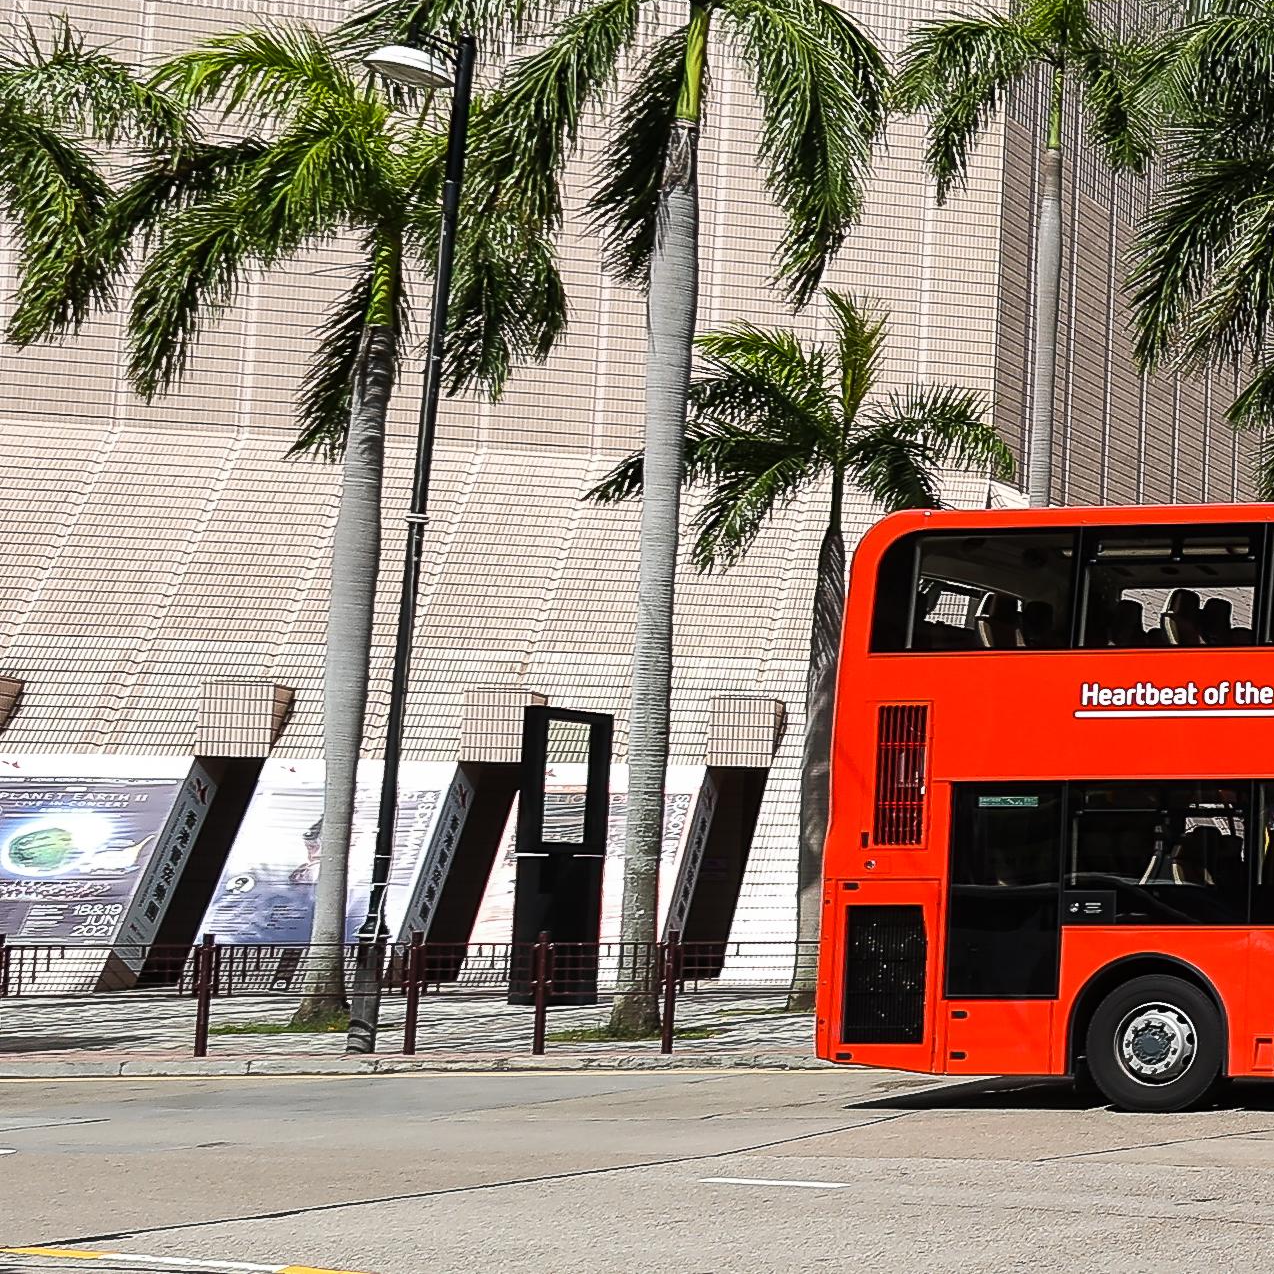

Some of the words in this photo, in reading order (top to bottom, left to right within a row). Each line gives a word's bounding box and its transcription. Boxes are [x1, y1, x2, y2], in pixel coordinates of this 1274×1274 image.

[1081, 683, 1198, 706] Heartbeat
[1204, 682, 1229, 705] of
[1234, 682, 1273, 705] the
[0, 792, 66, 800] PLANET
[73, 793, 130, 801] EARTH
[72, 903, 123, 915] 18&19
[82, 914, 120, 925] JUN
[69, 925, 115, 936] 2021
